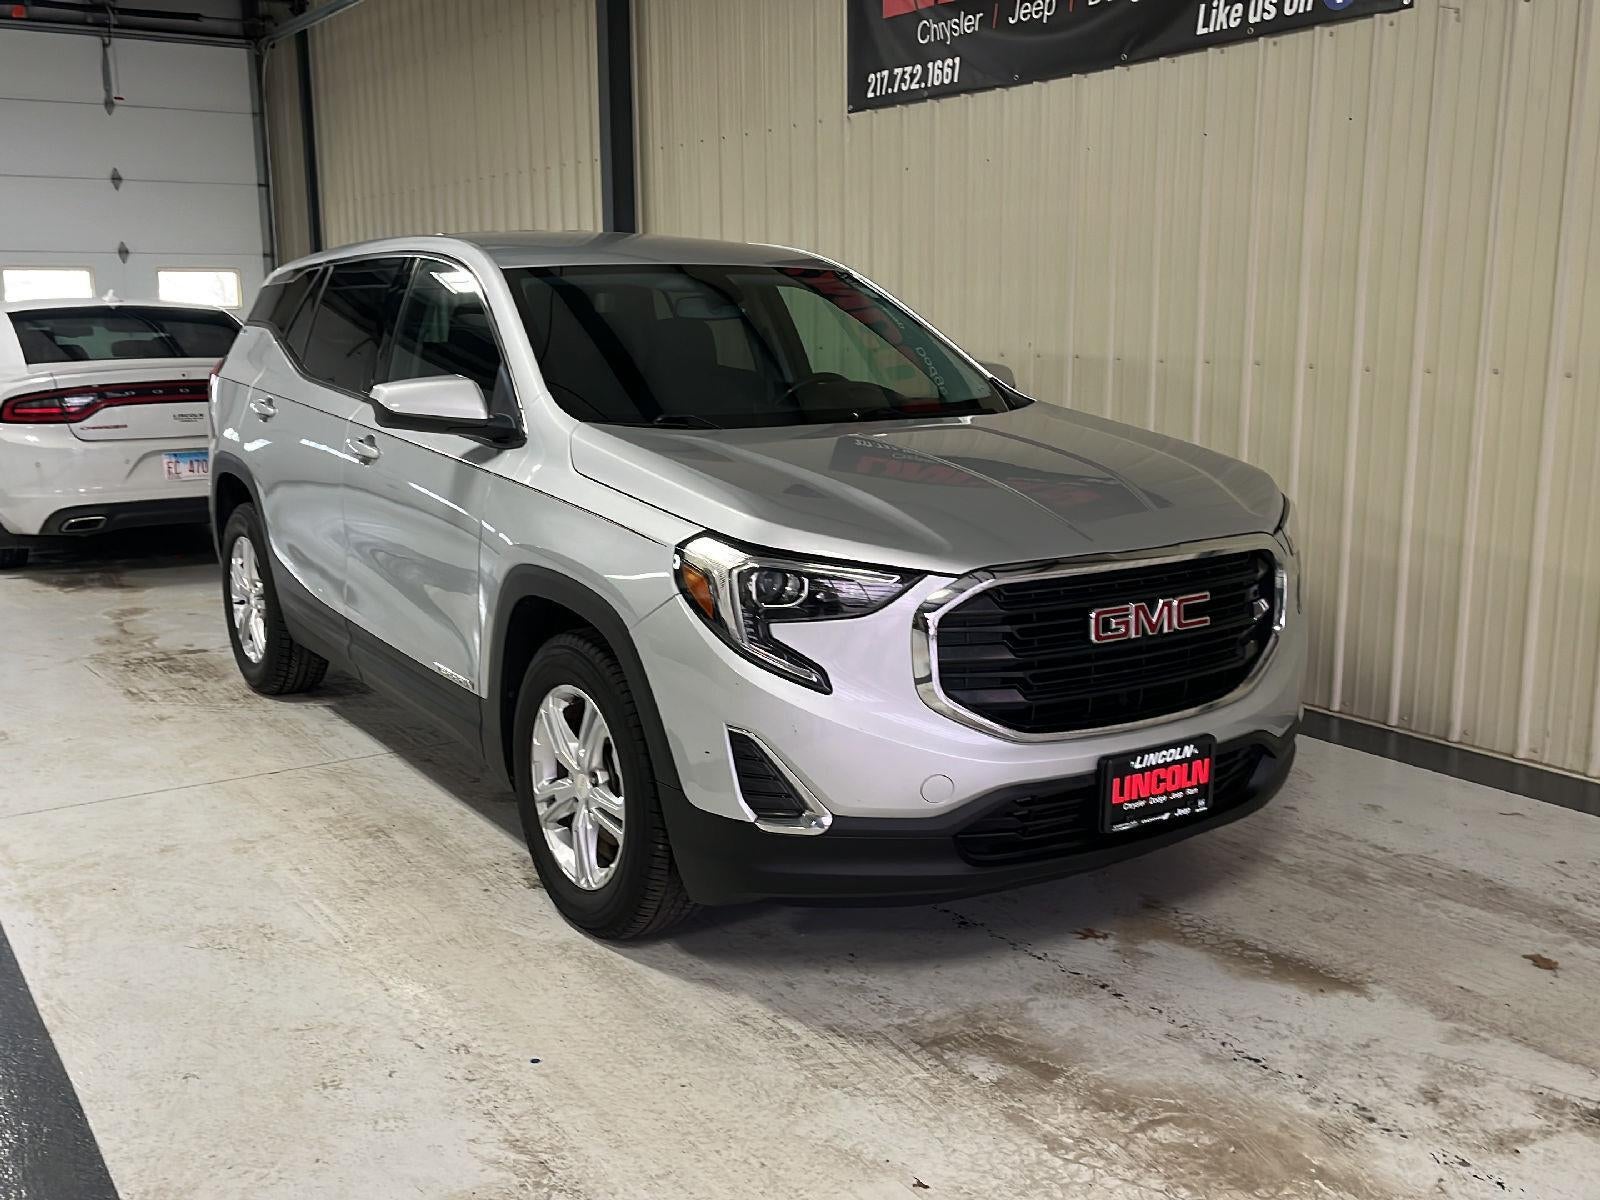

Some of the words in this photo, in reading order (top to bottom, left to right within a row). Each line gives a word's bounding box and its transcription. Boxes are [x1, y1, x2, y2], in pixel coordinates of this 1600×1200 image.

[917, 10, 984, 45] Chrysler
[1008, 0, 1057, 24] Jeep
[1195, 0, 1243, 36] Like
[1247, 0, 1278, 24] us
[866, 56, 962, 99] 217.732.1661
[1090, 591, 1211, 643] GMC
[1133, 744, 1195, 769] LINCOLN
[1111, 758, 1211, 804] LINCOLN
